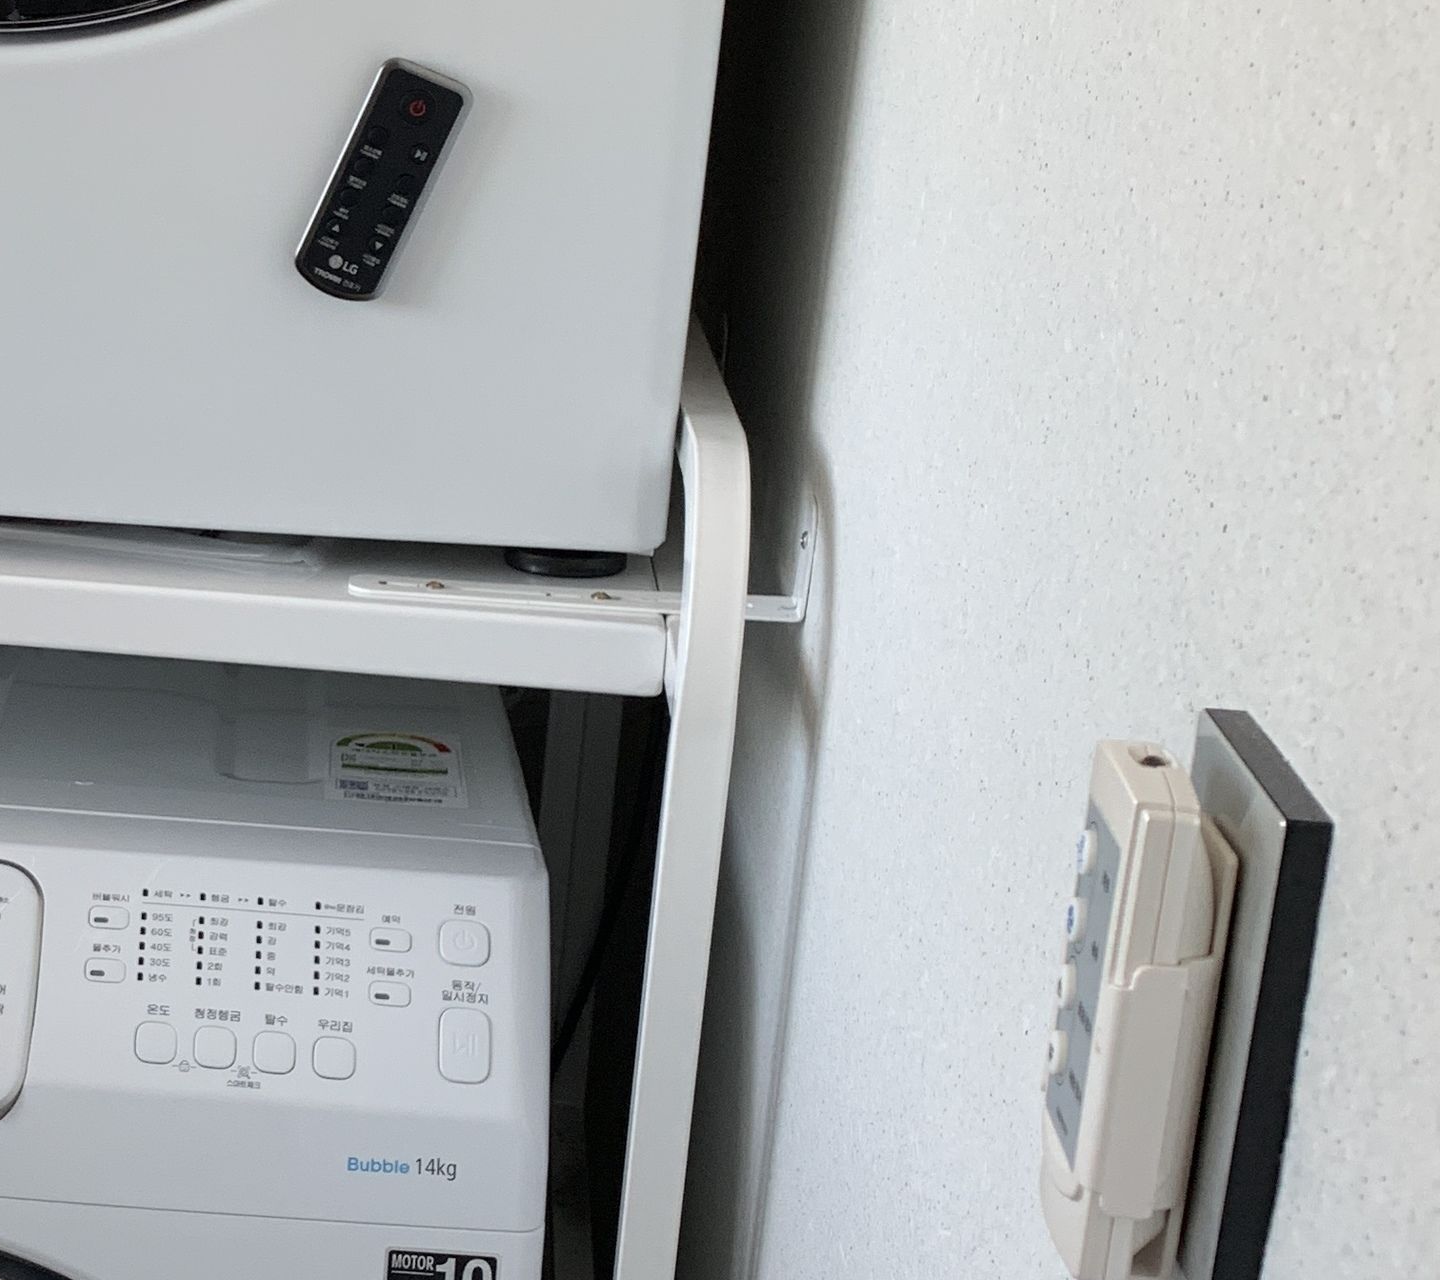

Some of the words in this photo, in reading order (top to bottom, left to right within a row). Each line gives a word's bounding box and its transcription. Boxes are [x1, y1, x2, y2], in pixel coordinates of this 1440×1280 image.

[342, 261, 359, 275] LG
[92, 892, 130, 903] 버블워시
[454, 904, 476, 916] 전원
[152, 912, 174, 922] 95도
[381, 914, 401, 924] 예약
[150, 927, 173, 937] 60도
[325, 926, 351, 937] 기억5
[92, 943, 121, 954] 물추가
[150, 943, 173, 952] 40도
[325, 941, 351, 951] 기억4
[149, 958, 171, 967] 30도
[325, 956, 351, 967] 기억3
[324, 971, 350, 982] 기억2
[366, 966, 415, 979] 세탁물추가
[324, 987, 349, 998] 기억1
[442, 990, 489, 1005] 일시정지
[147, 1003, 170, 1016] 온도
[194, 1008, 241, 1022] 청정헹굼
[265, 1014, 288, 1026] 탈수
[318, 1019, 353, 1033] 우리집
[347, 1157, 410, 1174] Bubble
[415, 1158, 457, 1181] 14kg
[391, 1253, 435, 1271] MOTOR
